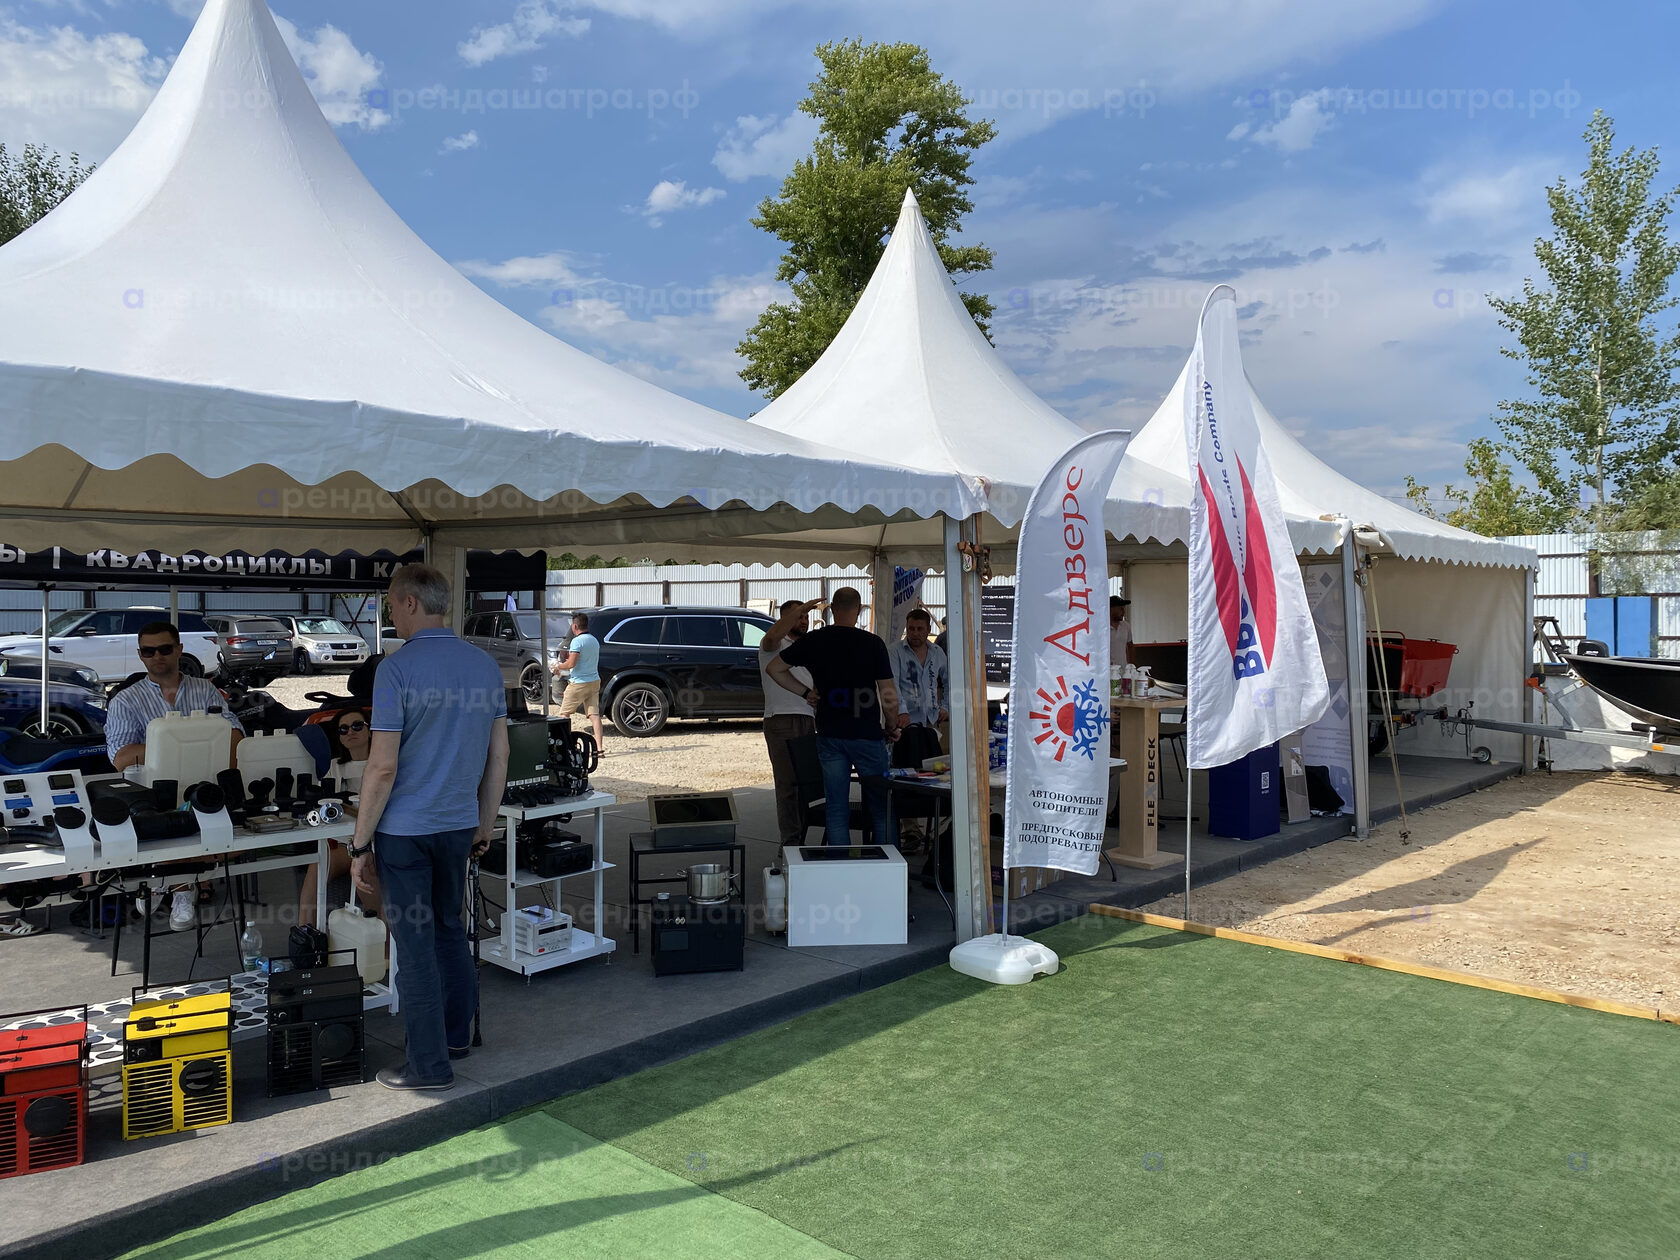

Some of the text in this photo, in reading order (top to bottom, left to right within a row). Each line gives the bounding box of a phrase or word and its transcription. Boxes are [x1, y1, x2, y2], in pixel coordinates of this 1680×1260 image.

[1203, 381, 1225, 463] Company
[87, 549, 332, 576] КВАДРОЦИКЛЫ
[1043, 466, 1095, 667] Адверс
[1028, 789, 1105, 806] АВТОНОМНЫЕ
[1032, 800, 1099, 817] ОТОПИТЕЛИ
[1021, 822, 1104, 841] ПРЕДПУСКОВЫЕ
